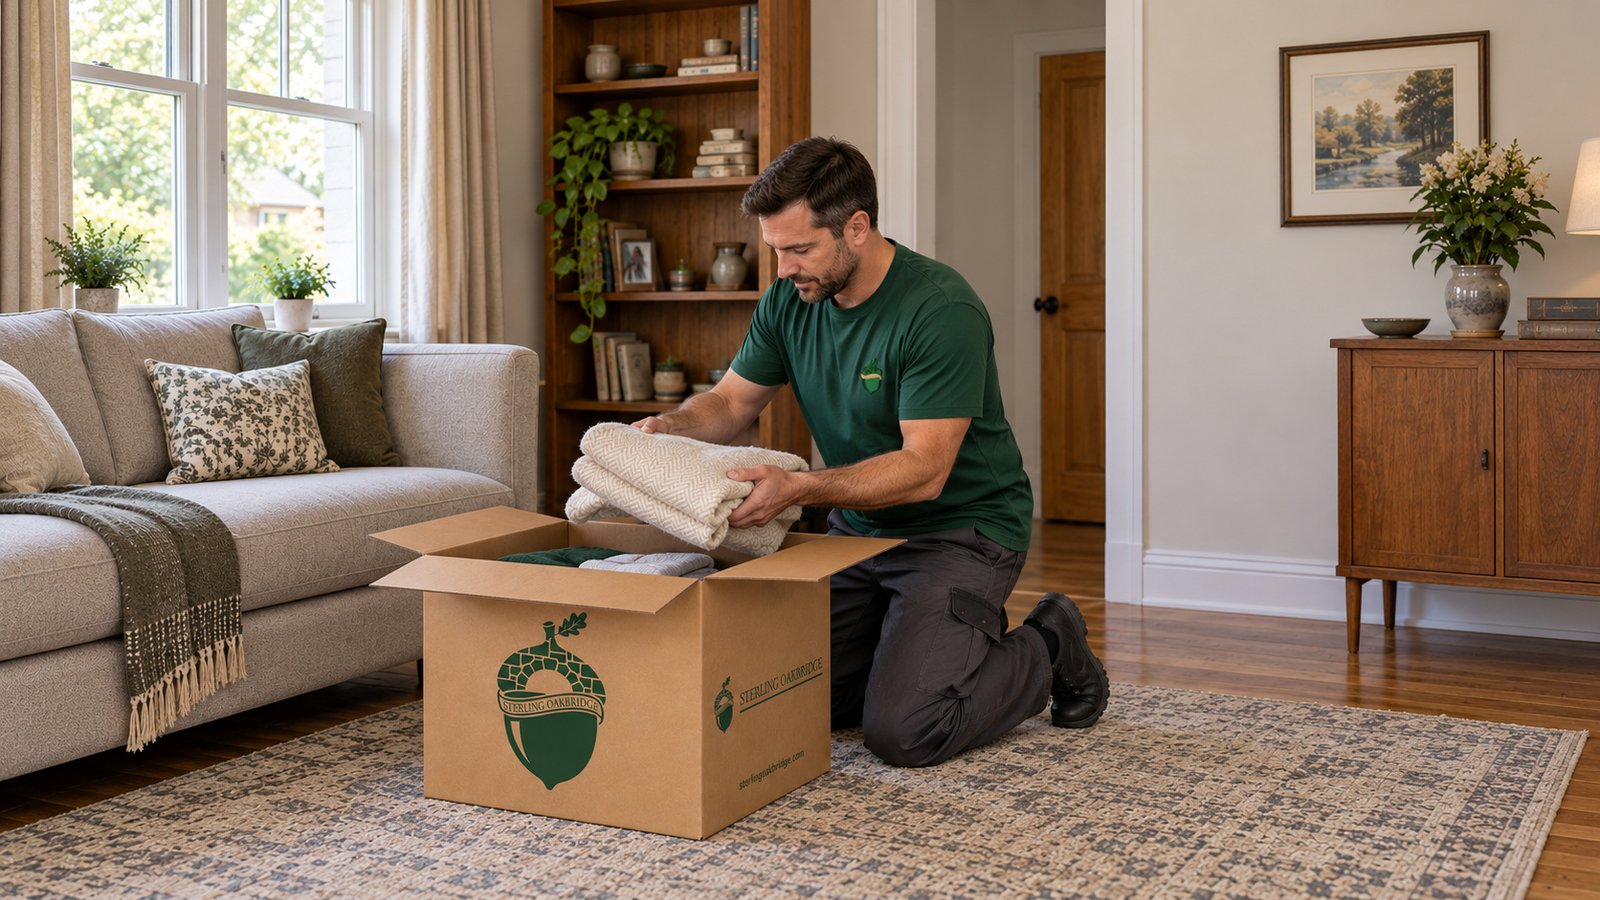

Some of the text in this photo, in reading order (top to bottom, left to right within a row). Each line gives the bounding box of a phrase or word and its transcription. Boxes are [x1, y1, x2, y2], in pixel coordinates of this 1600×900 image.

[739, 657, 823, 706] STERLING OAKBRIDGE
[503, 697, 599, 713] STERLING OAKBRIDGE
